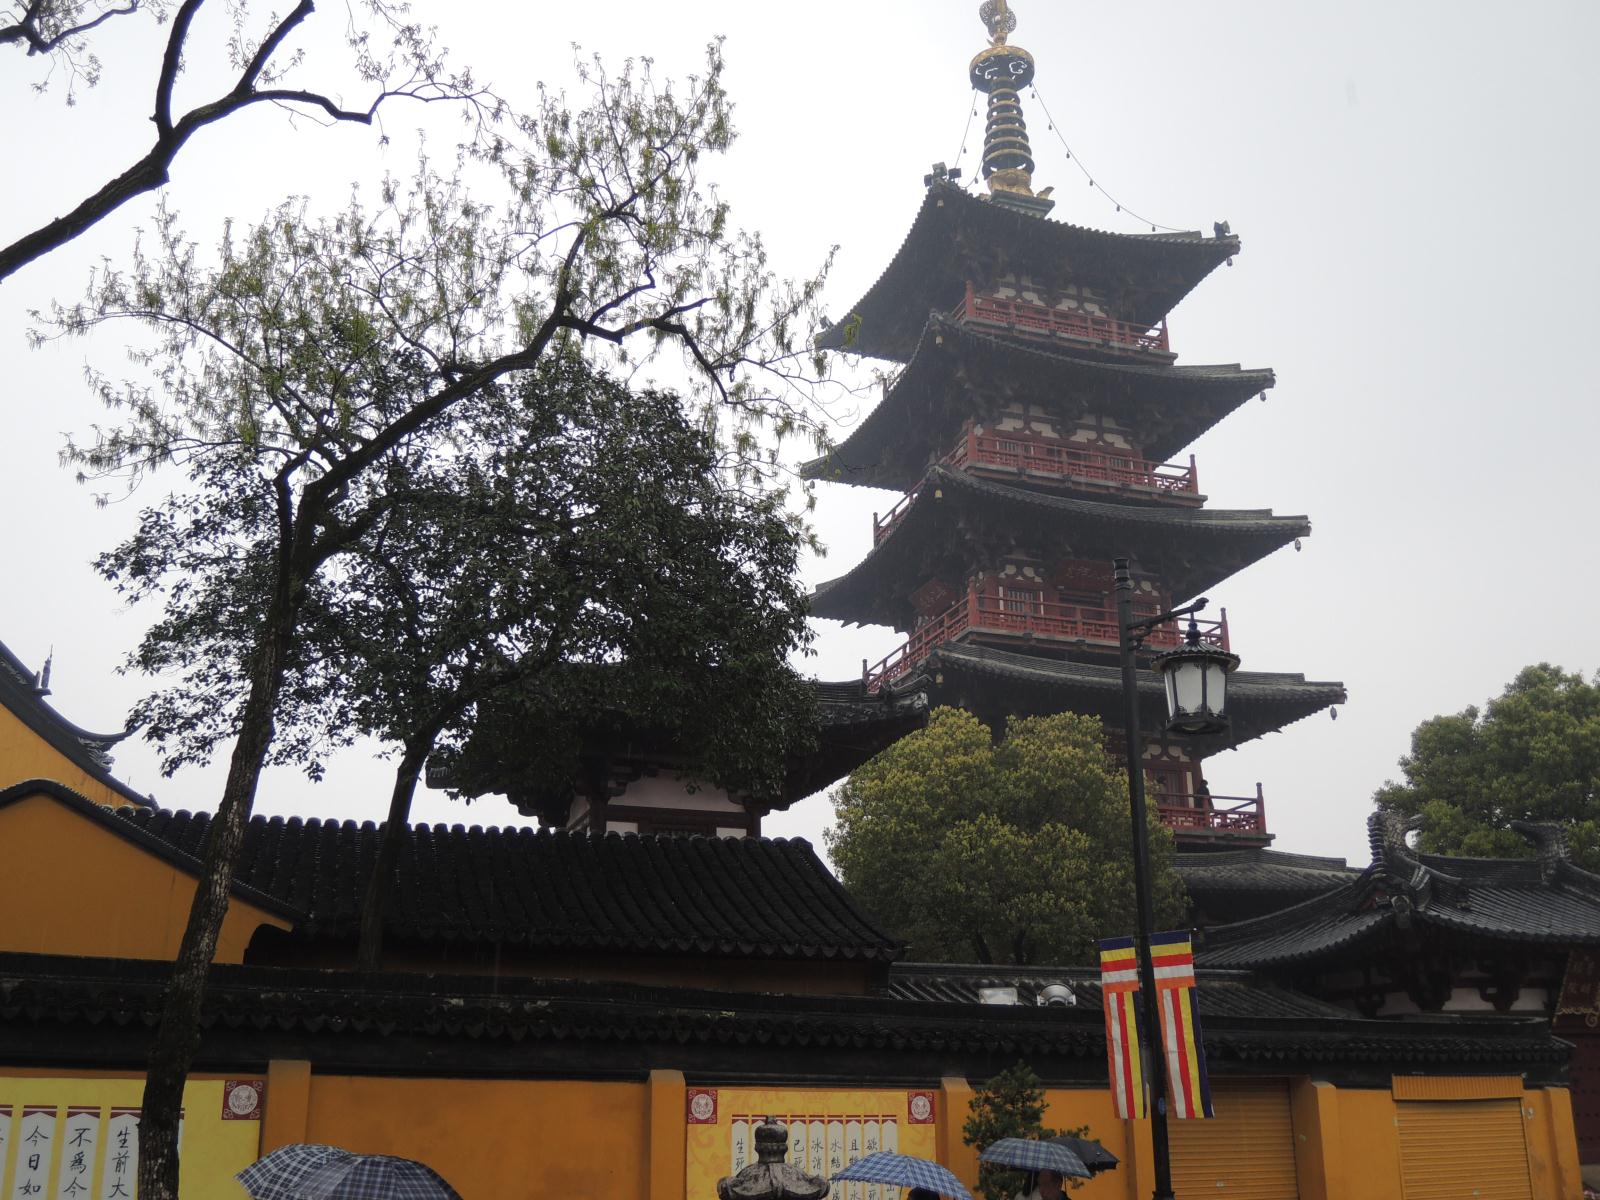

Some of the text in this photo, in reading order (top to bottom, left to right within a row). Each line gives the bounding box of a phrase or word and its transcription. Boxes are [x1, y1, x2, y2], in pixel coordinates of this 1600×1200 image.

[18, 1125, 50, 1195] 今日如
[108, 1126, 131, 1198] 生前大
